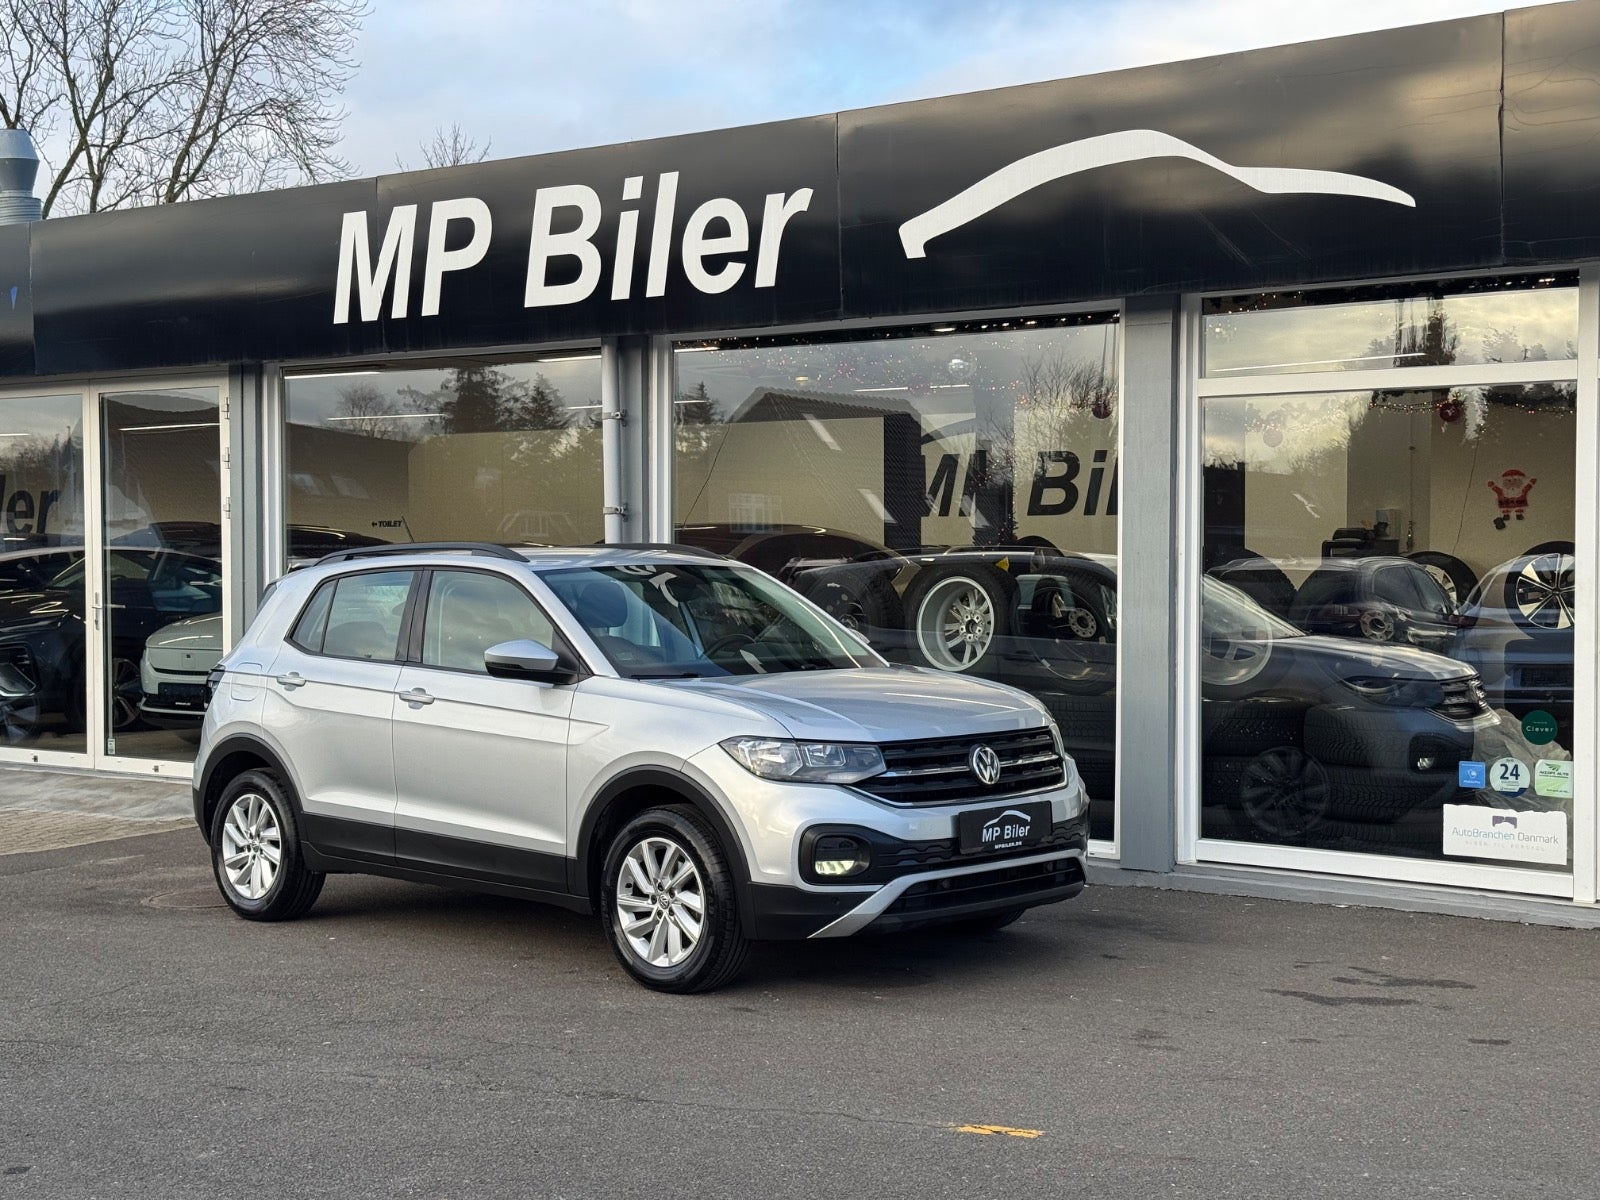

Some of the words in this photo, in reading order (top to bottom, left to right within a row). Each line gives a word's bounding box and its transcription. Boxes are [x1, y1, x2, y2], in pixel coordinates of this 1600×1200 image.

[333, 197, 492, 324] MP
[524, 171, 814, 308] Biler
[378, 520, 402, 528] TOILET
[1500, 764, 1520, 780] 24
[982, 827, 1001, 842] MP
[1004, 824, 1030, 839] Biler
[1452, 827, 1515, 841] AutoBranchen
[1518, 832, 1559, 844] Danmark
